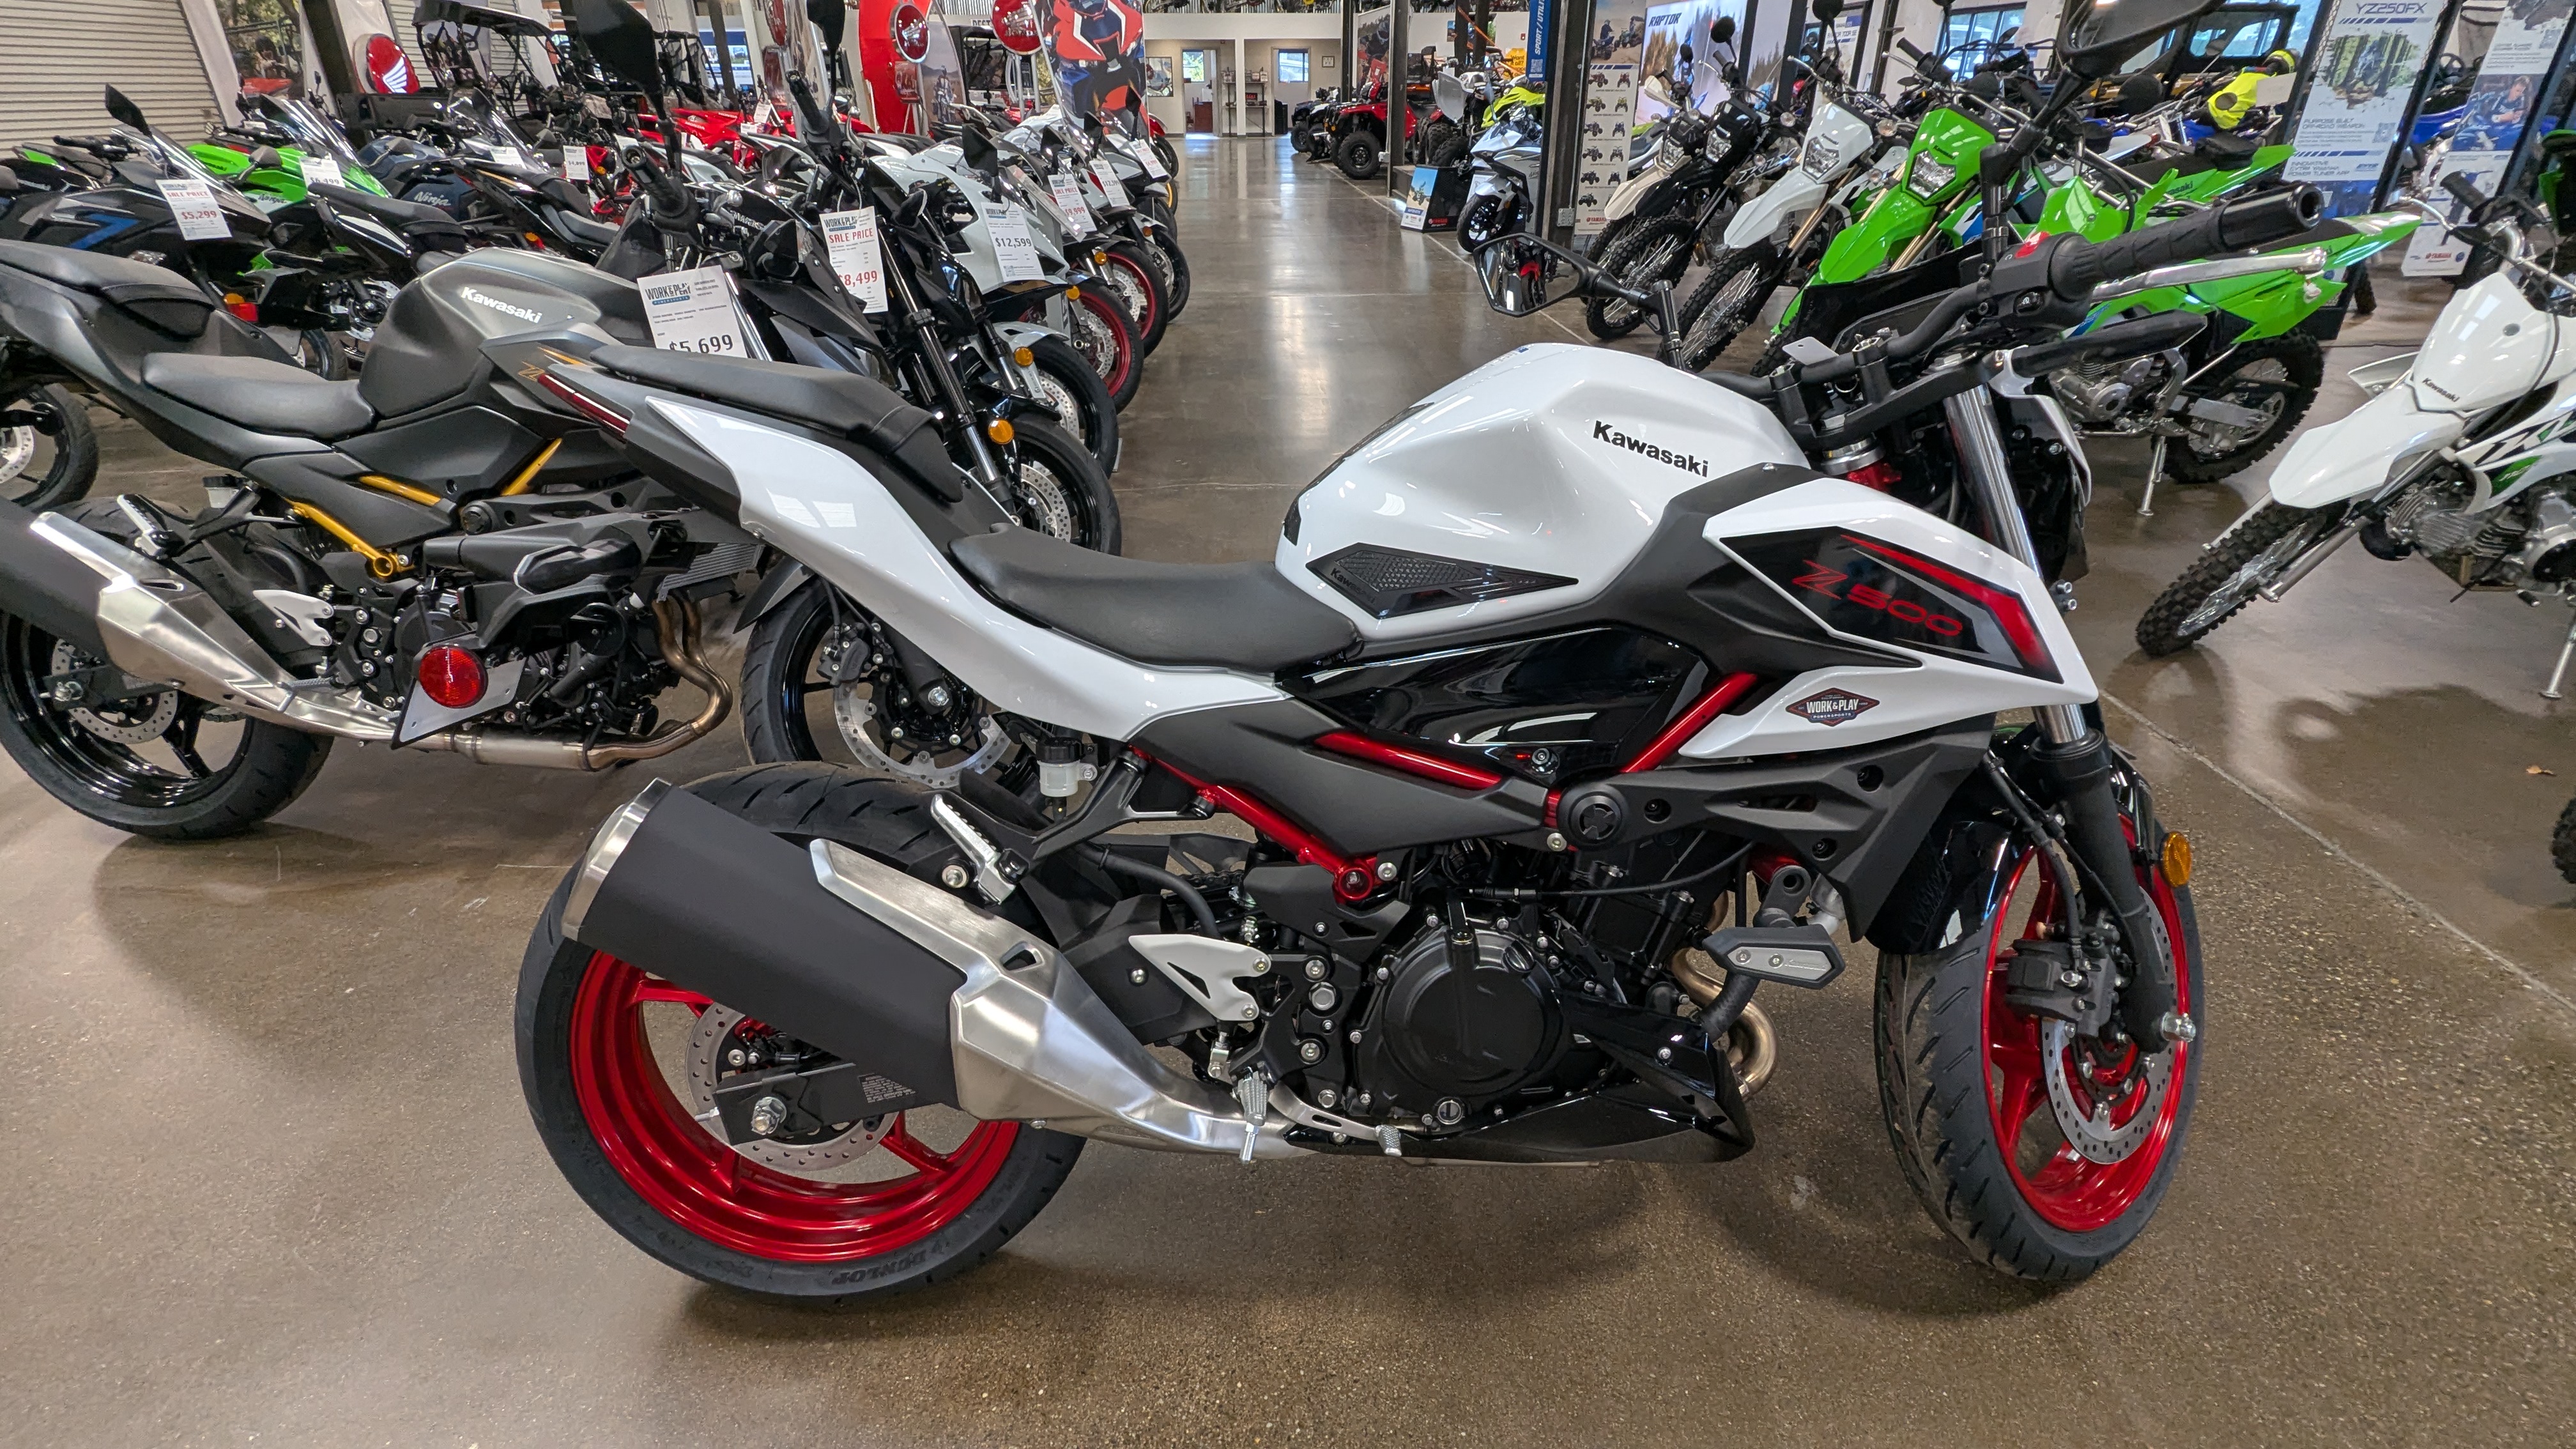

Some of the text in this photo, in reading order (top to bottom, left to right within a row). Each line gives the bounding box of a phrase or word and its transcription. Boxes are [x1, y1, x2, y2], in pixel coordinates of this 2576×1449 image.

[2356, 3, 2428, 13] YZ250FX
[1648, 12, 1682, 27] RAPTOR
[414, 191, 452, 206] Ninja
[181, 210, 217, 220] $5,299
[829, 228, 874, 243] SALE PRICE
[995, 237, 1032, 248] $12,599
[838, 270, 878, 288] 8,499
[461, 286, 542, 323] Kawasaki
[2421, 378, 2460, 402] Kawasaki
[1593, 420, 1709, 477] Kawasaki
